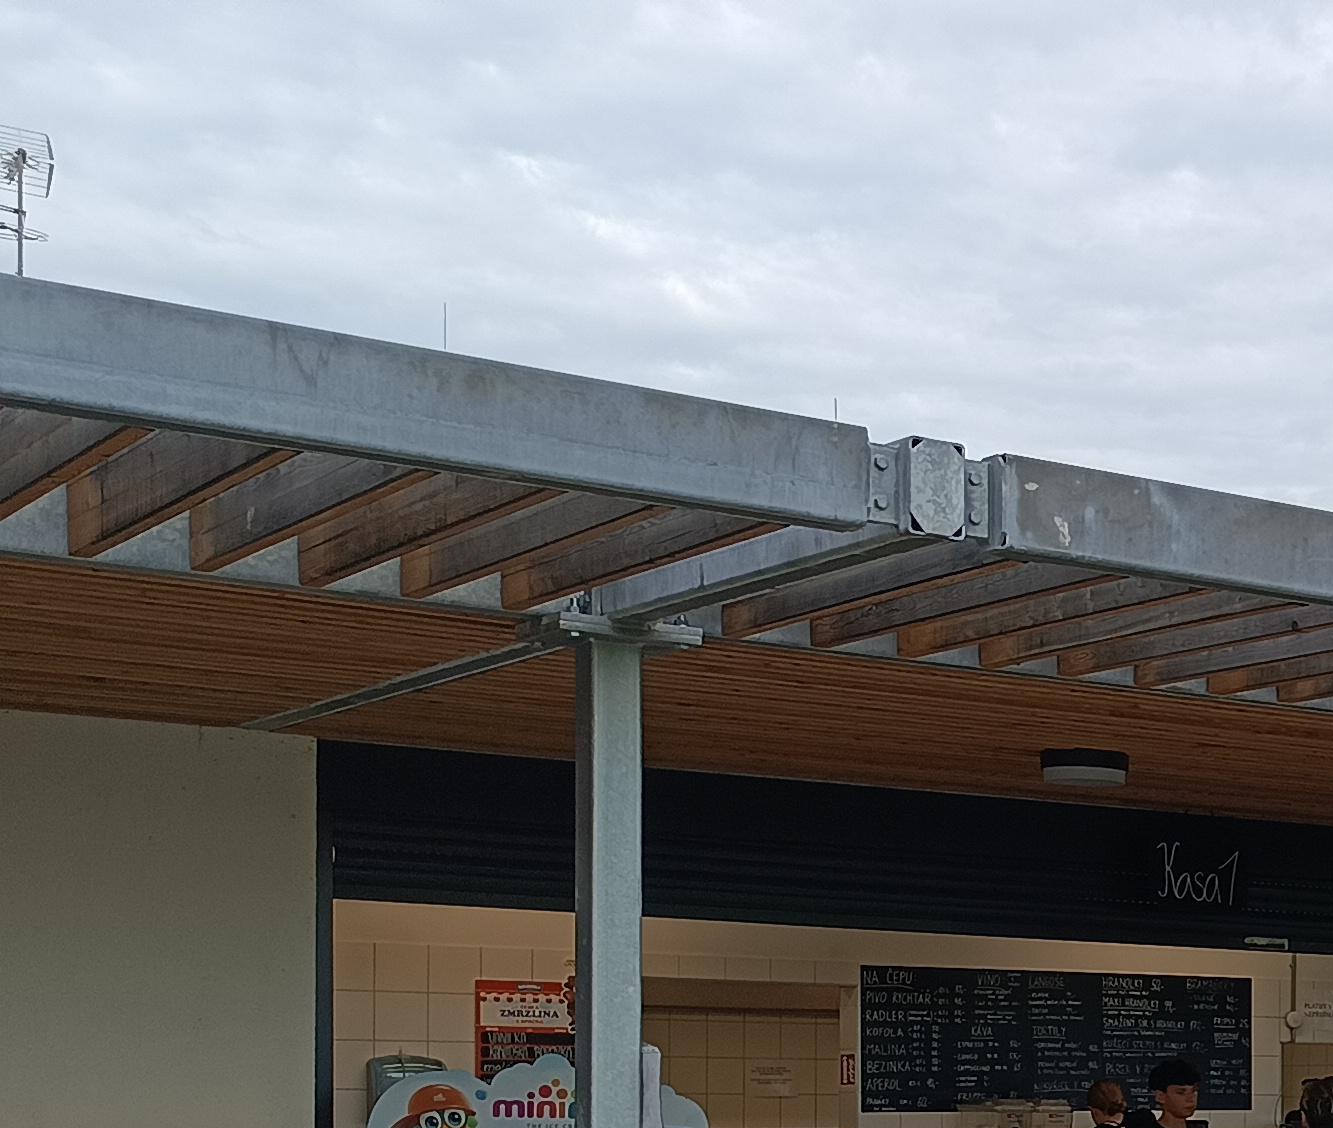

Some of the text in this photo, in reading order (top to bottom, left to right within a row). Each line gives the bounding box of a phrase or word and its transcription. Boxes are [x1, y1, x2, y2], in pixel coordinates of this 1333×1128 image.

[1156, 841, 1240, 906] Kasa 1
[863, 970, 879, 984] NA
[499, 1008, 559, 1019] ZMRZLINA
[865, 1010, 905, 1022] RADLER
[865, 1026, 904, 1038] KOFOLA
[865, 1044, 907, 1056] MALINA
[866, 1060, 911, 1074] BEZINKA
[865, 1078, 903, 1091] APEROL
